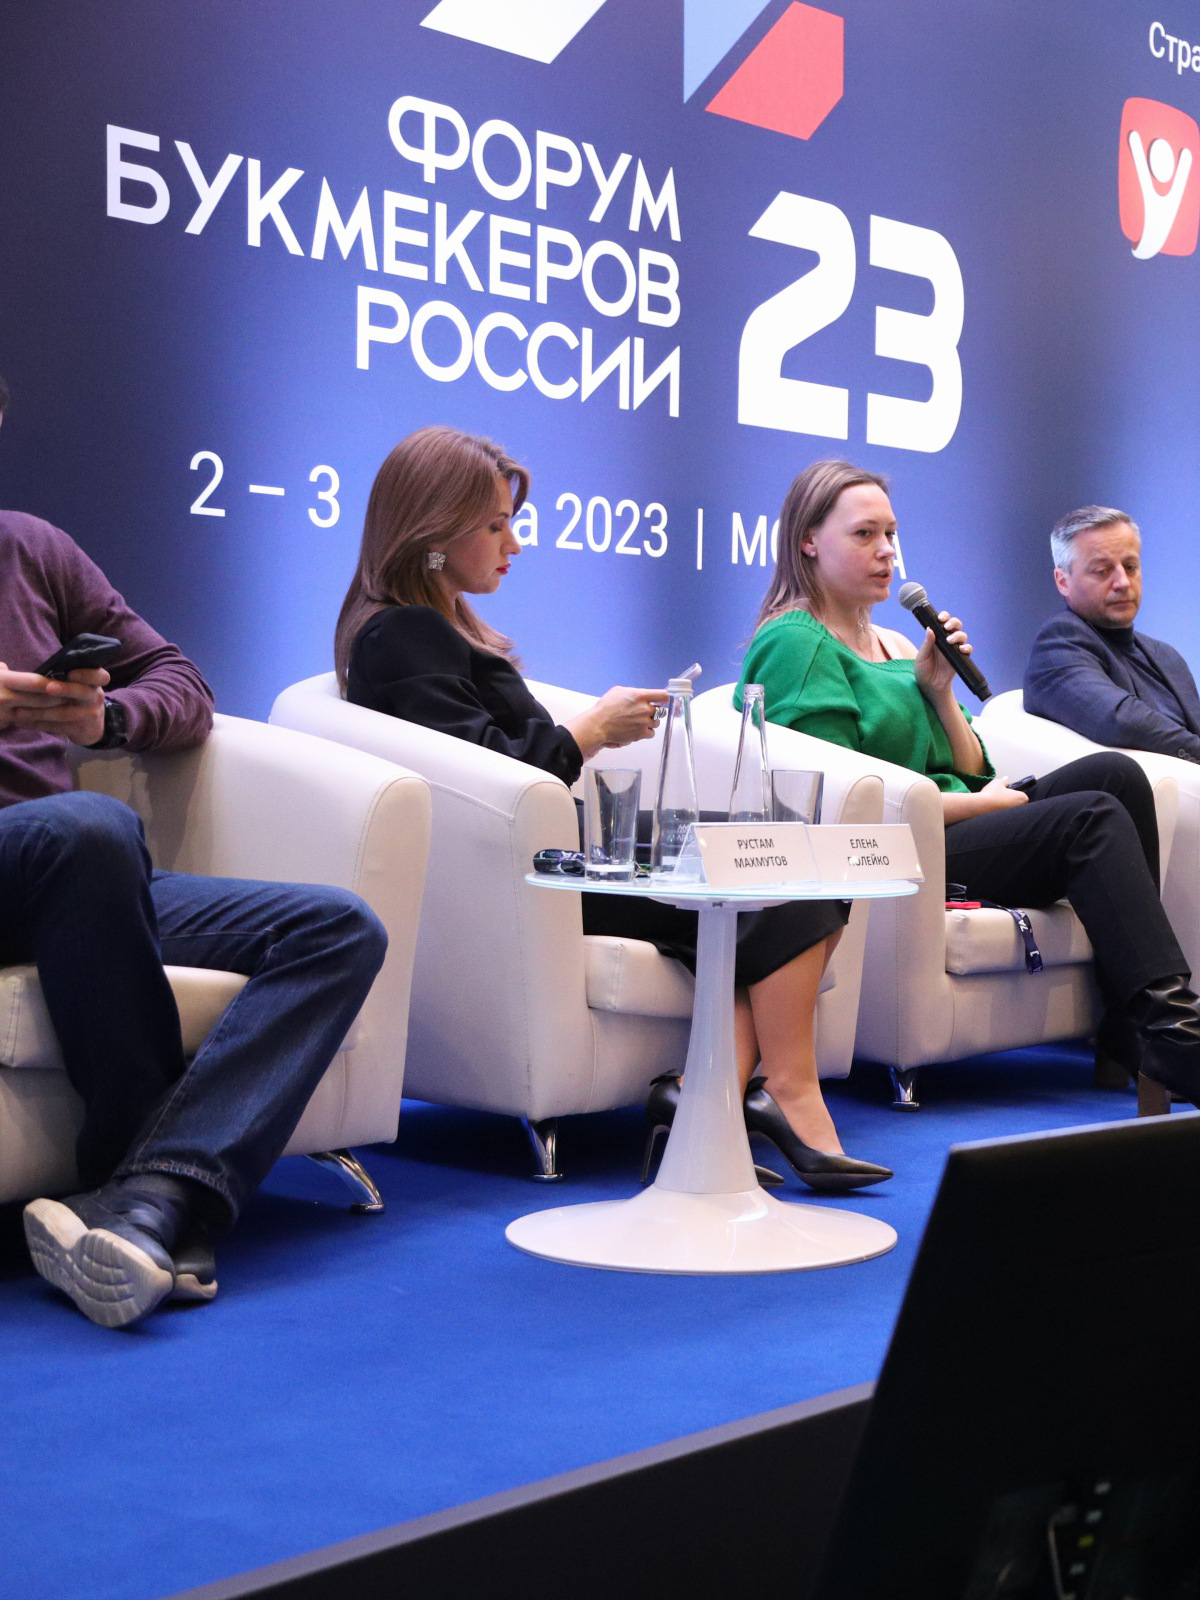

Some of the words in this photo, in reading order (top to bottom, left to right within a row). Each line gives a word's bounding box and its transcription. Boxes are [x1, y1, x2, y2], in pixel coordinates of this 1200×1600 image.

[106, 124, 681, 328] БУКМЕКЕРОВ
[388, 95, 681, 241] ФОРУМ
[356, 285, 681, 418] РОССИИ
[738, 190, 964, 453] 23
[189, 450, 226, 518] 2
[308, 465, 341, 528] 3
[555, 492, 668, 558] 2023
[734, 856, 788, 868] МАХМУТОВ
[737, 838, 775, 850] РУСТАМ
[849, 838, 879, 849] ЕЛЕНА
